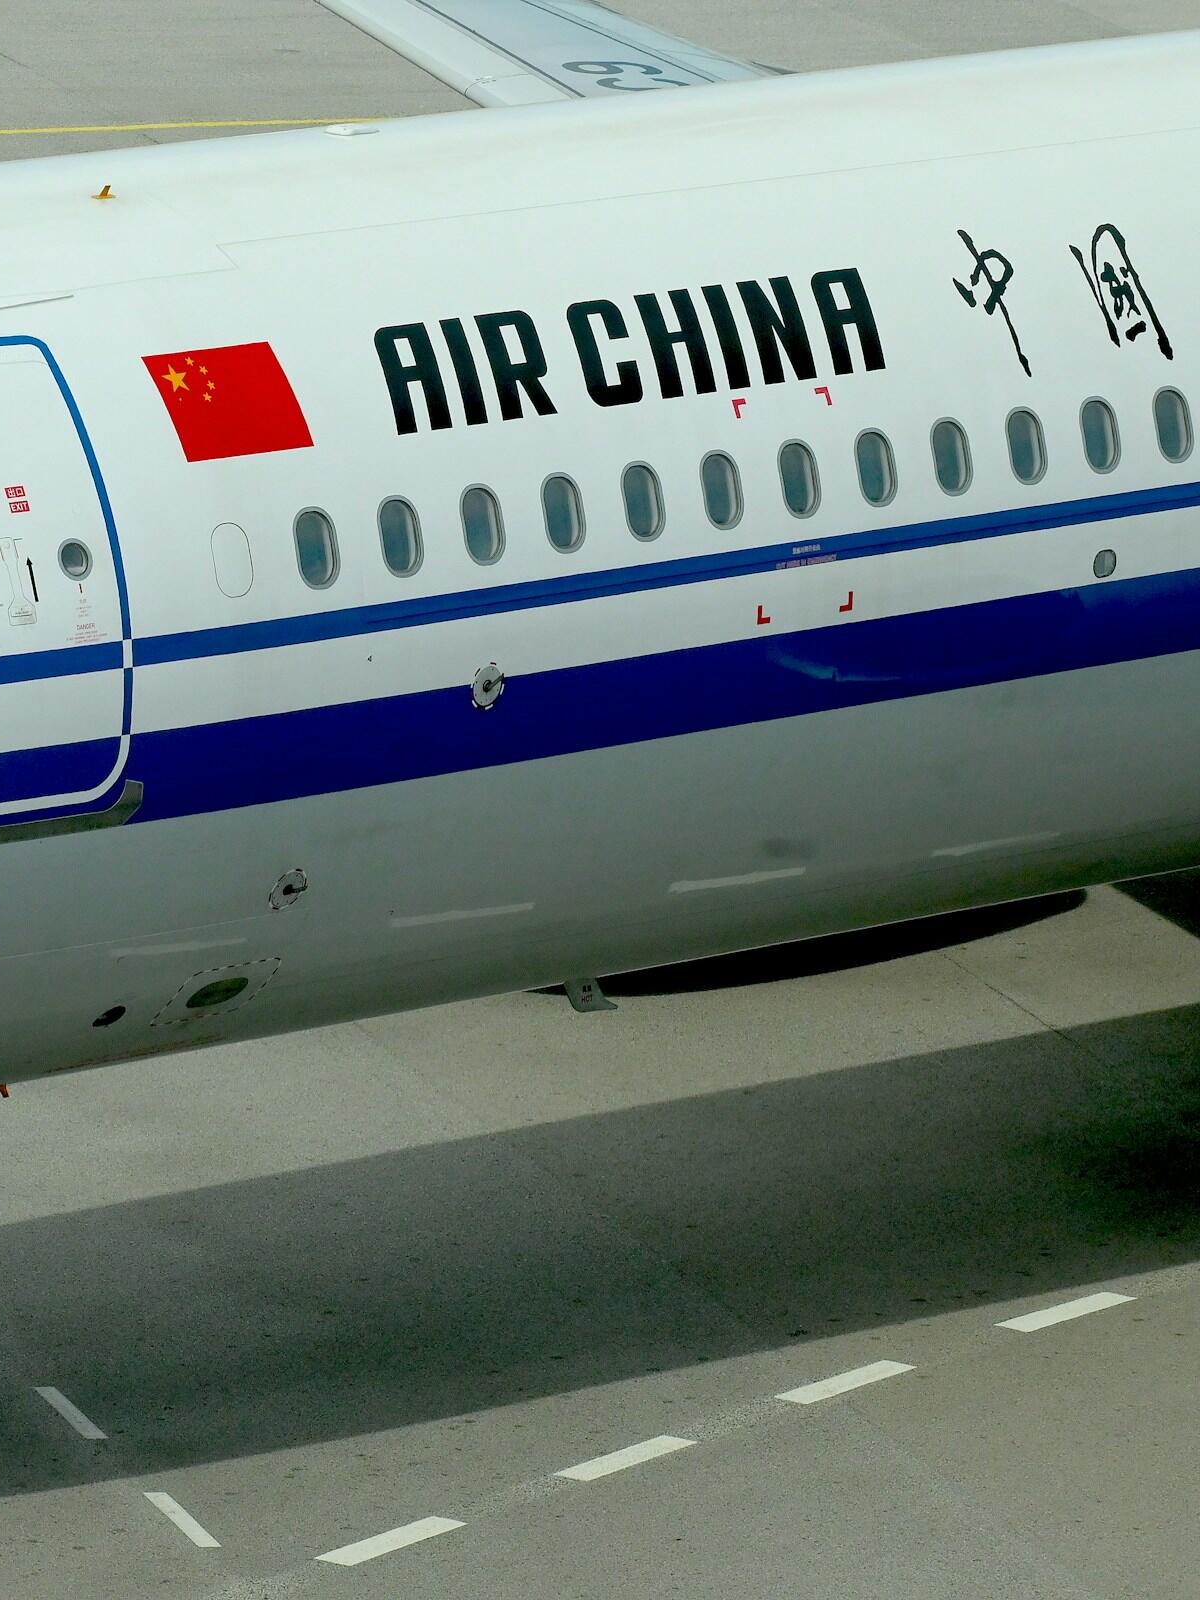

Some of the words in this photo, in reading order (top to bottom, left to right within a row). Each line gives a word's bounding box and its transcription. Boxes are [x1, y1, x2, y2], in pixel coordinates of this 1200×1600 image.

[374, 310, 558, 435] AIR
[566, 267, 887, 407] CHINA
[10, 502, 29, 512] EXIT
[76, 622, 95, 631] DANGER
